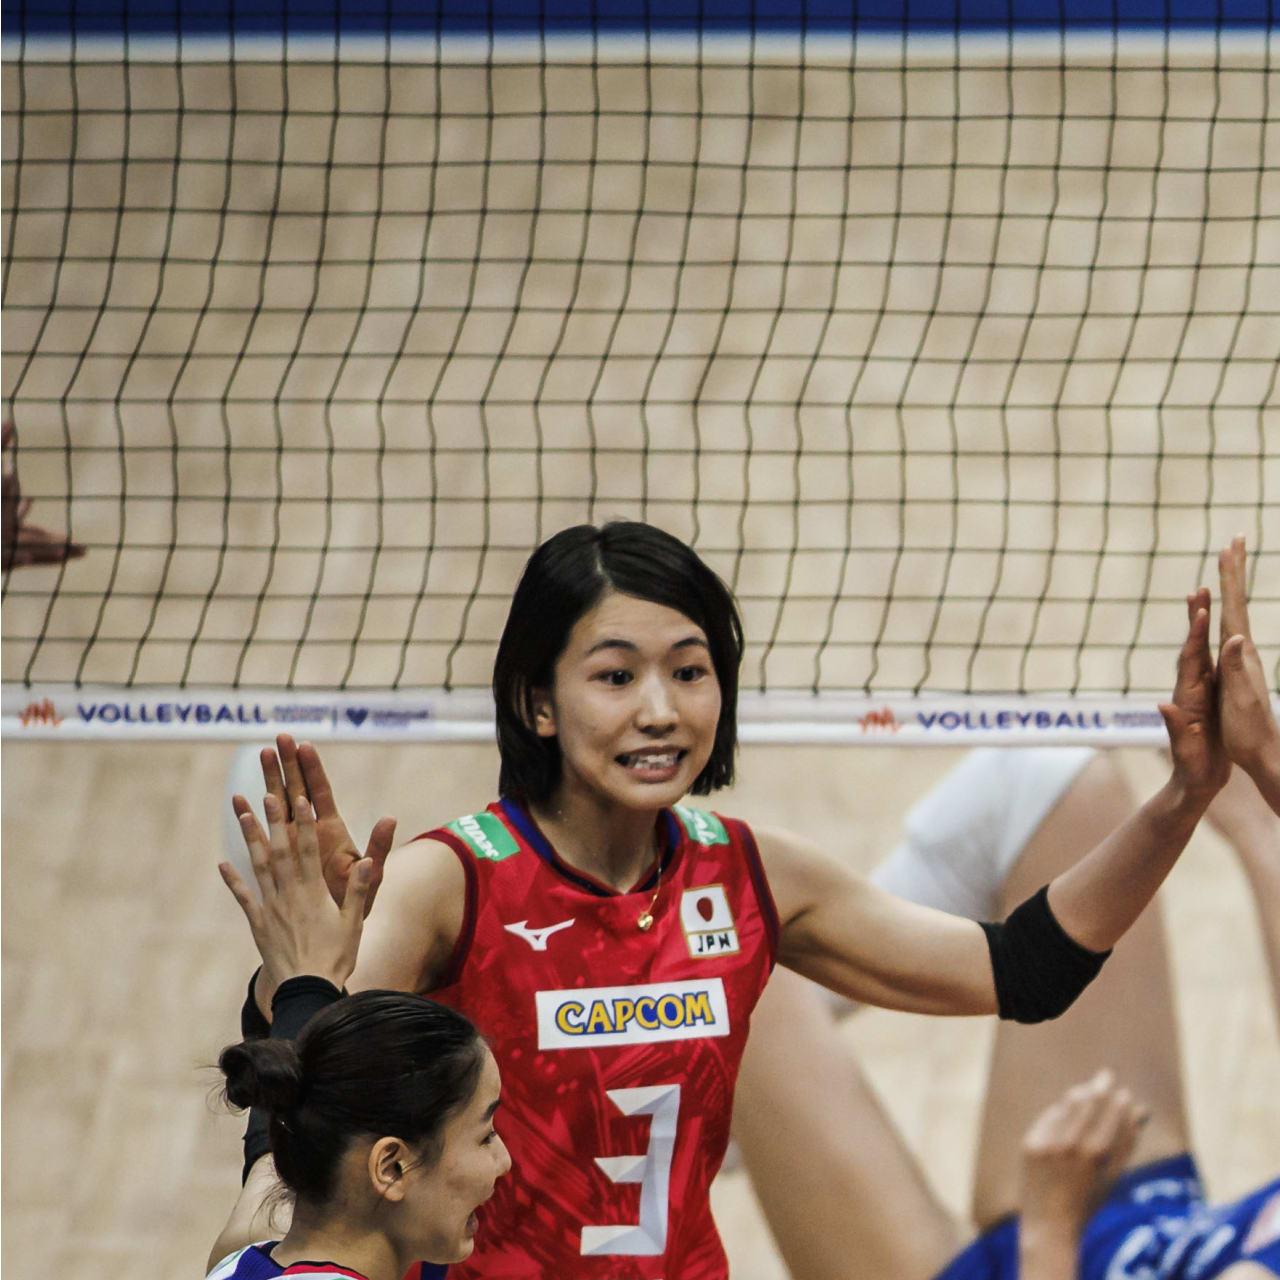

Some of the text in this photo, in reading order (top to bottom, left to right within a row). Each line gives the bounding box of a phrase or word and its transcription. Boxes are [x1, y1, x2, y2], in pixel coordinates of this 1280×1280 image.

[77, 703, 267, 724] VOLLEYBALL
[916, 710, 1107, 730] VOLLEYBALL
[698, 933, 731, 953] JPN
[555, 990, 715, 1036] CAPCOM
[580, 1084, 681, 1256] 3
